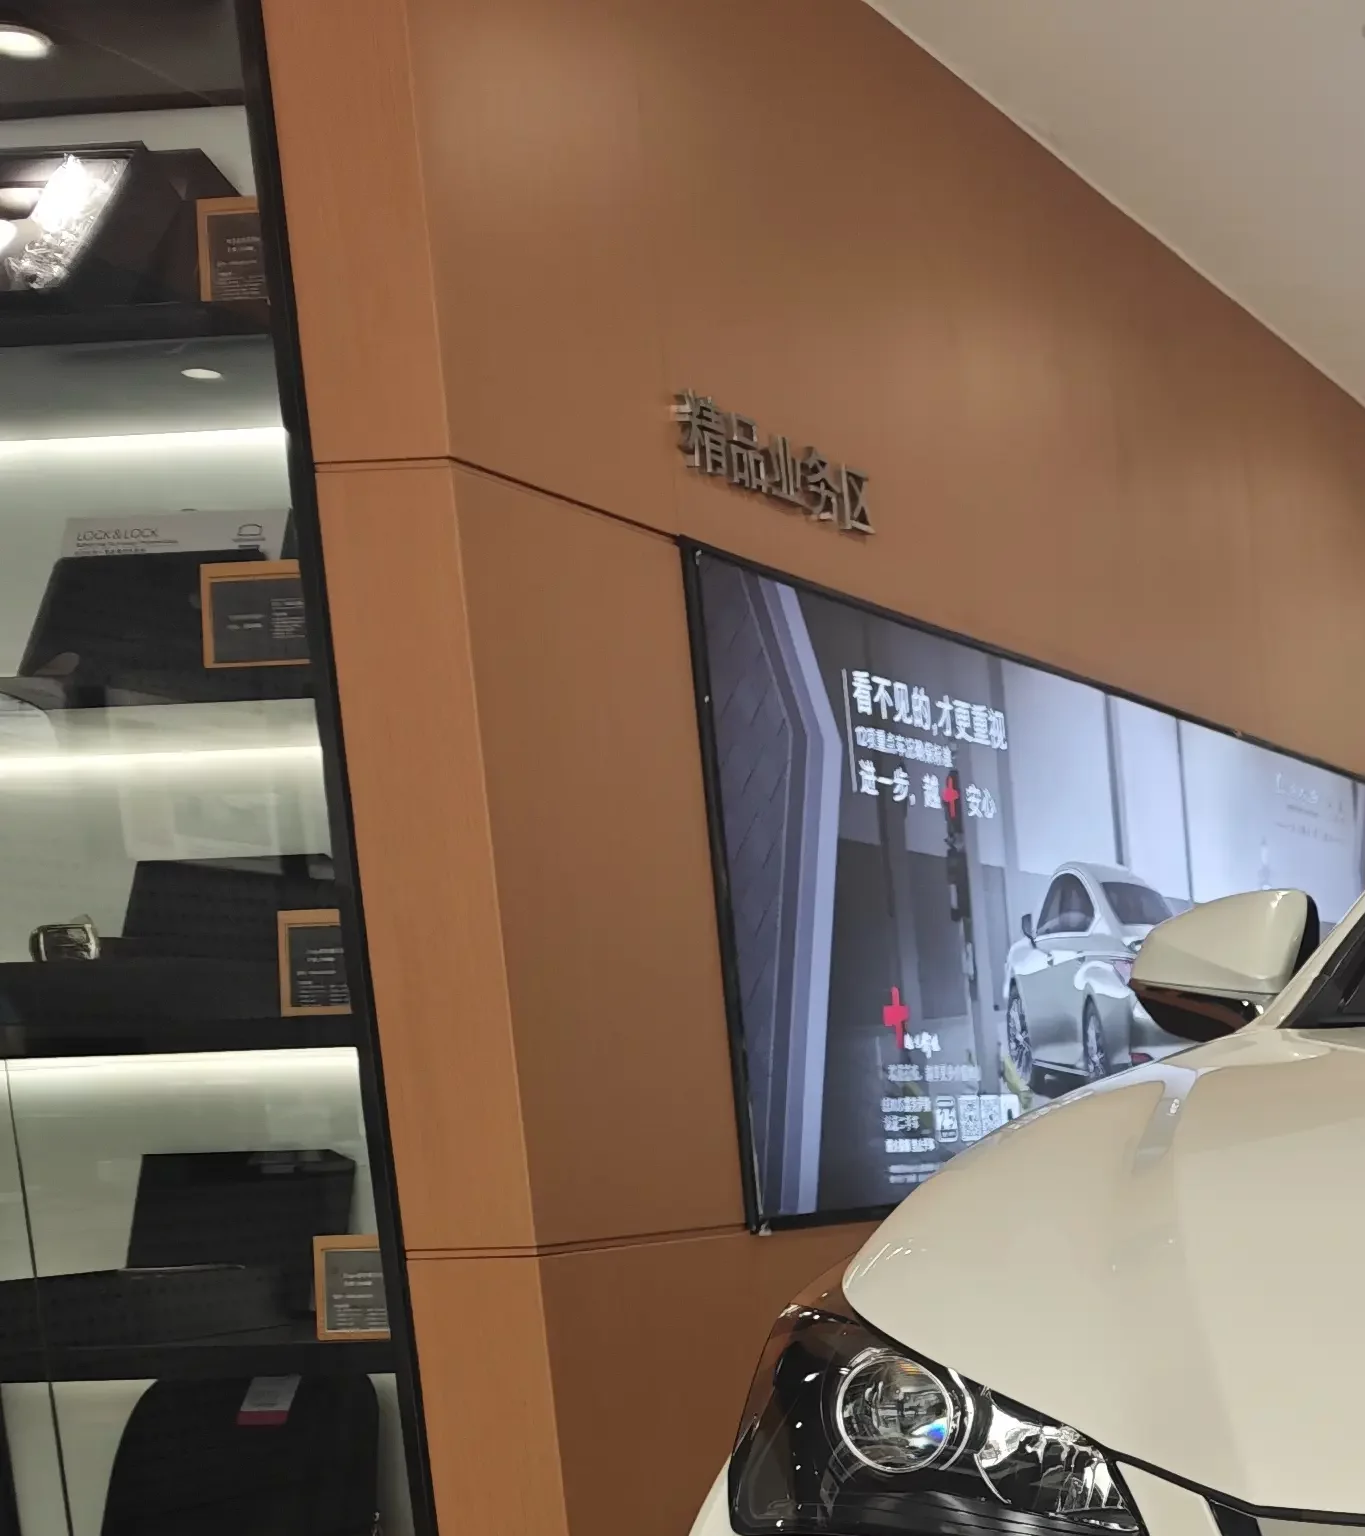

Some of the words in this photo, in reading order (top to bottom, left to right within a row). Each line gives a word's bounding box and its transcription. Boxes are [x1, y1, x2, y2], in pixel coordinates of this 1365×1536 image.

[672, 388, 876, 535] 精品业务区
